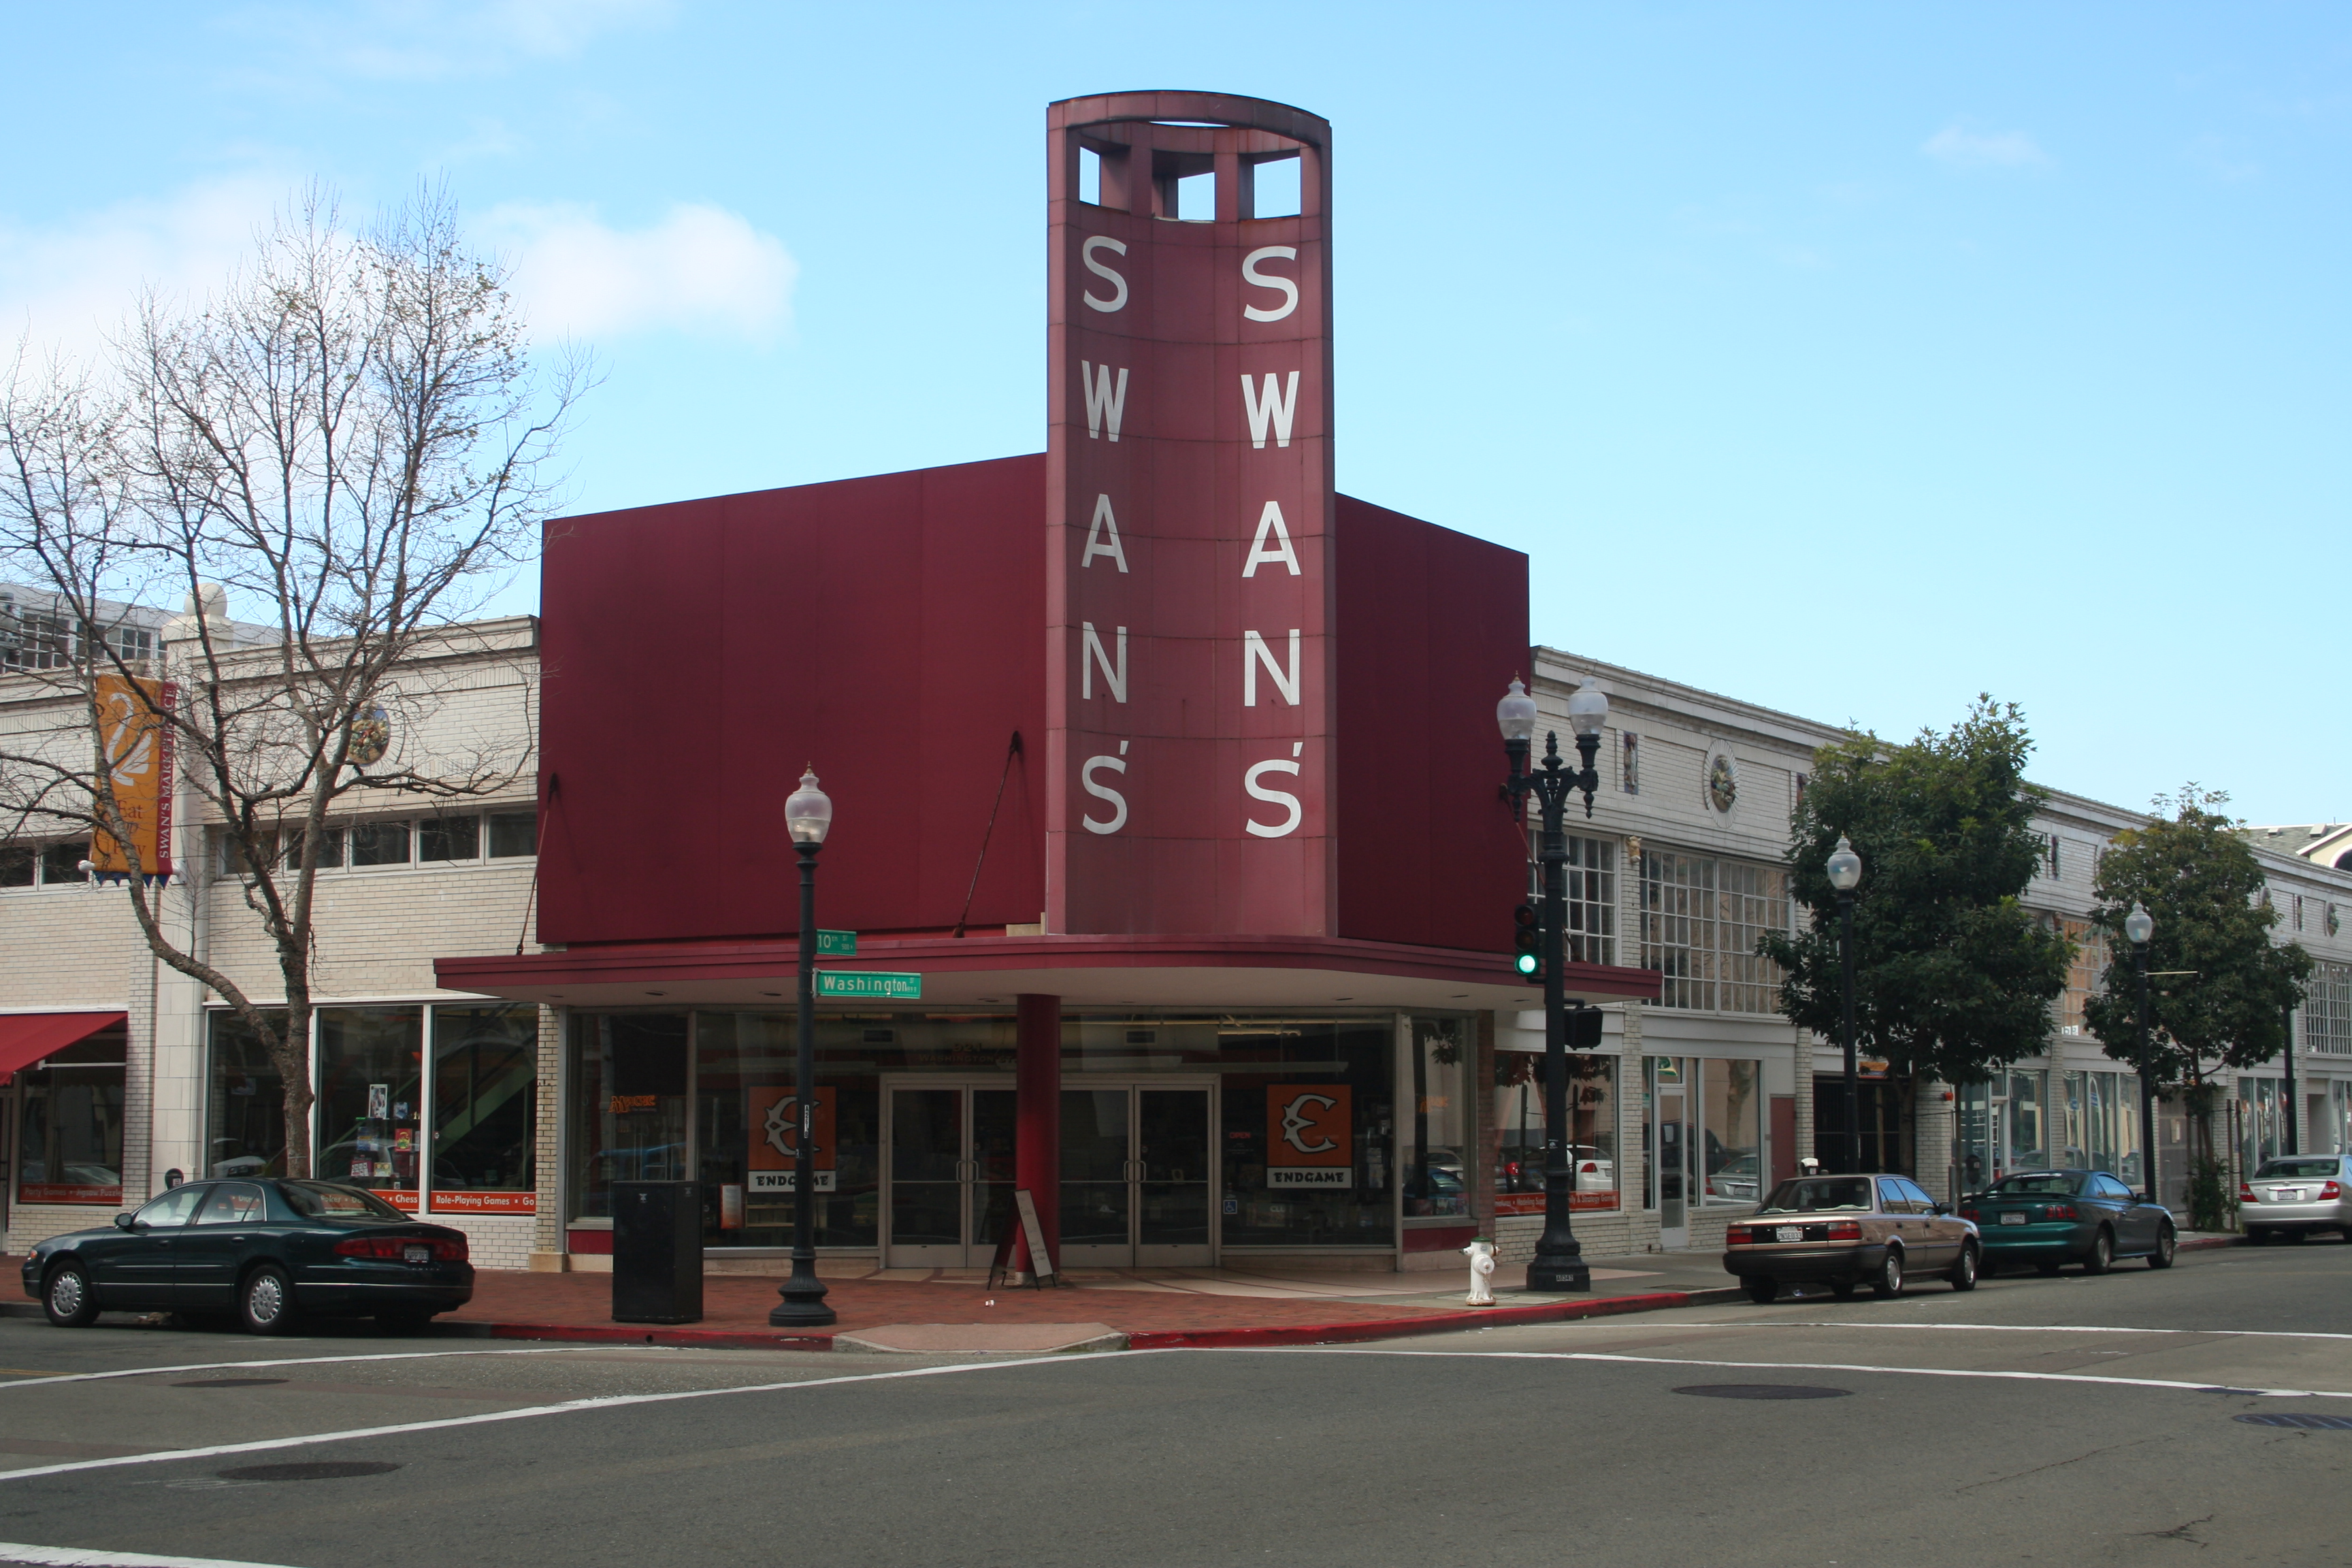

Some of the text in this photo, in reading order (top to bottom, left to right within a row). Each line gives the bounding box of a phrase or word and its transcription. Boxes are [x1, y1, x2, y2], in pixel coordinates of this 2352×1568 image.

[1081, 235, 1129, 835] SWAN'S
[1241, 245, 1303, 838] SWAN'S
[159, 688, 176, 858] SWAN'S MARKETPCE
[116, 800, 143, 819] Eat
[823, 976, 907, 992] Washington
[953, 1043, 982, 1052] 921
[919, 1054, 994, 1062] WASHINGTON
[755, 1175, 829, 1186] ENDGE
[1273, 1172, 1344, 1183] ENDGAME
[44, 1188, 67, 1196] Games
[395, 1194, 418, 1203] Chess
[436, 1194, 535, 1207] Role-Playing Games Go
[1582, 1194, 1600, 1205] Strategy
[1601, 1194, 1616, 1202] Games
